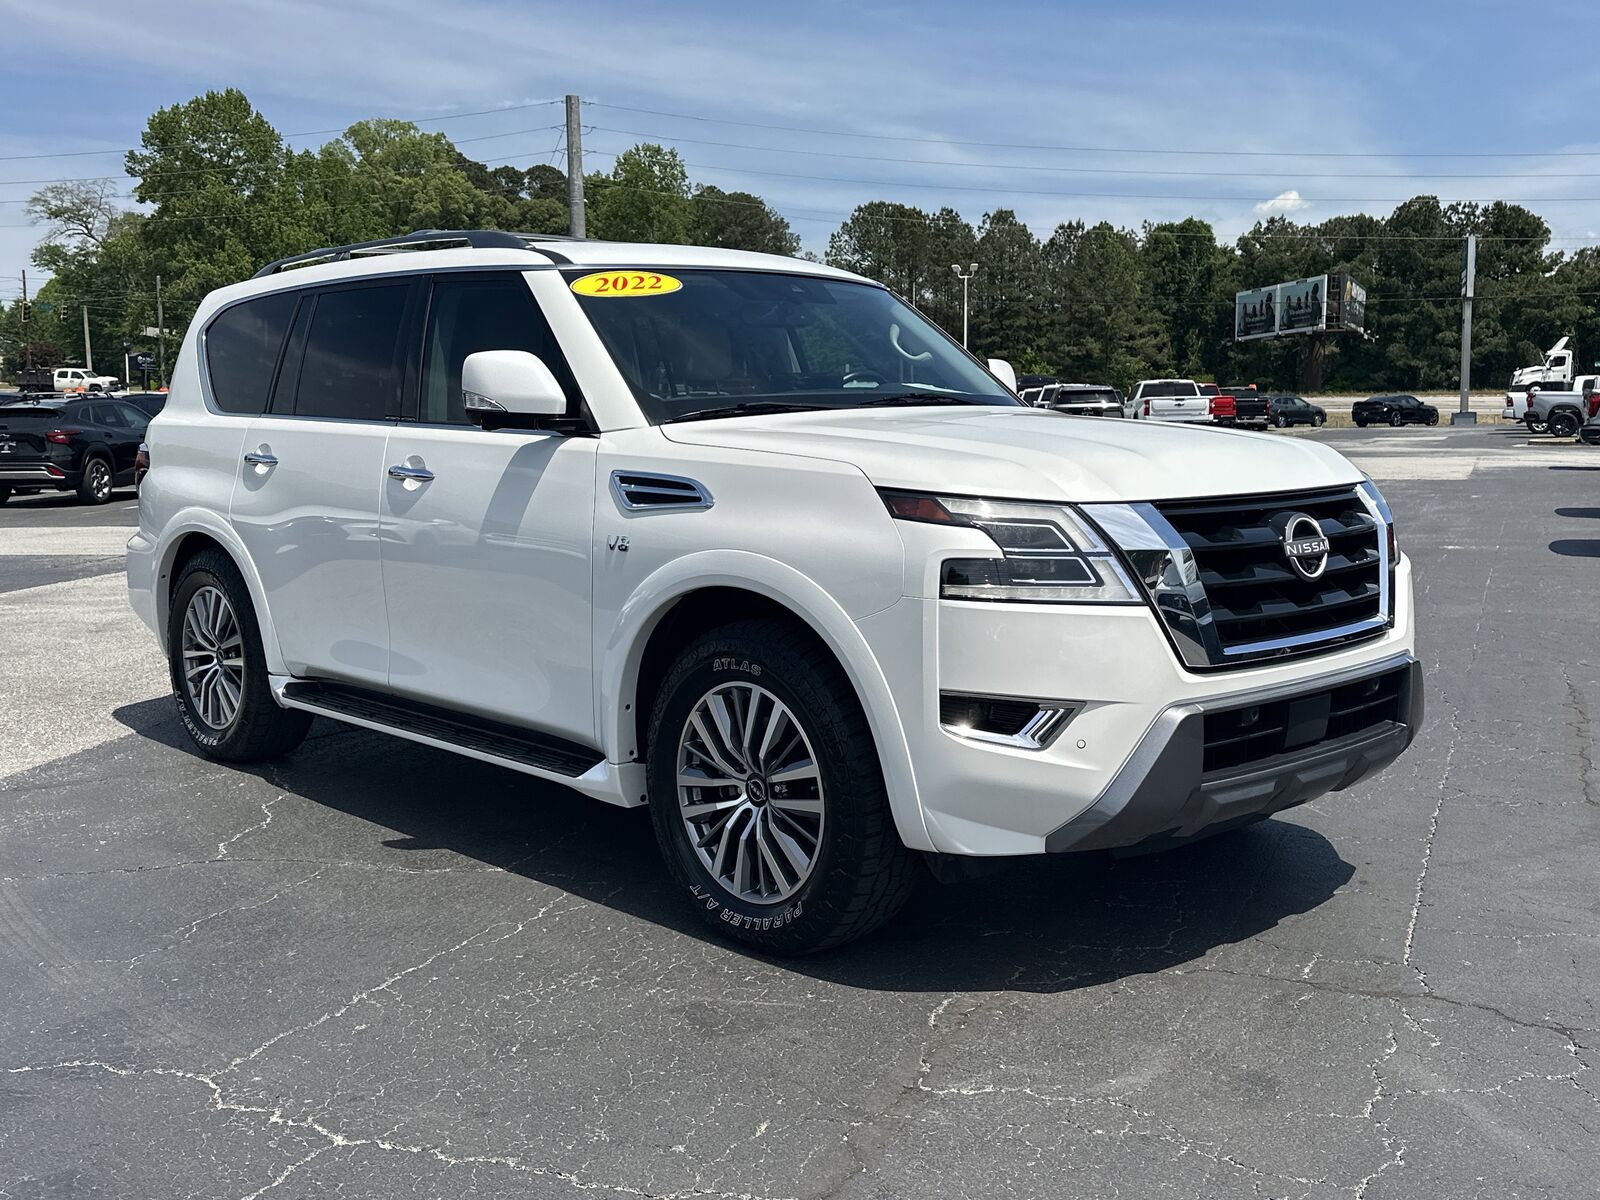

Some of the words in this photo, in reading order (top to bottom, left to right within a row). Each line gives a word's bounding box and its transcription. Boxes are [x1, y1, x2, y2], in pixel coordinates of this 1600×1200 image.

[594, 275, 662, 292] 2022
[607, 535, 630, 552] V8
[713, 657, 762, 676] ATLAS
[690, 884, 719, 910] A/T
[720, 901, 802, 930] PARALLER
